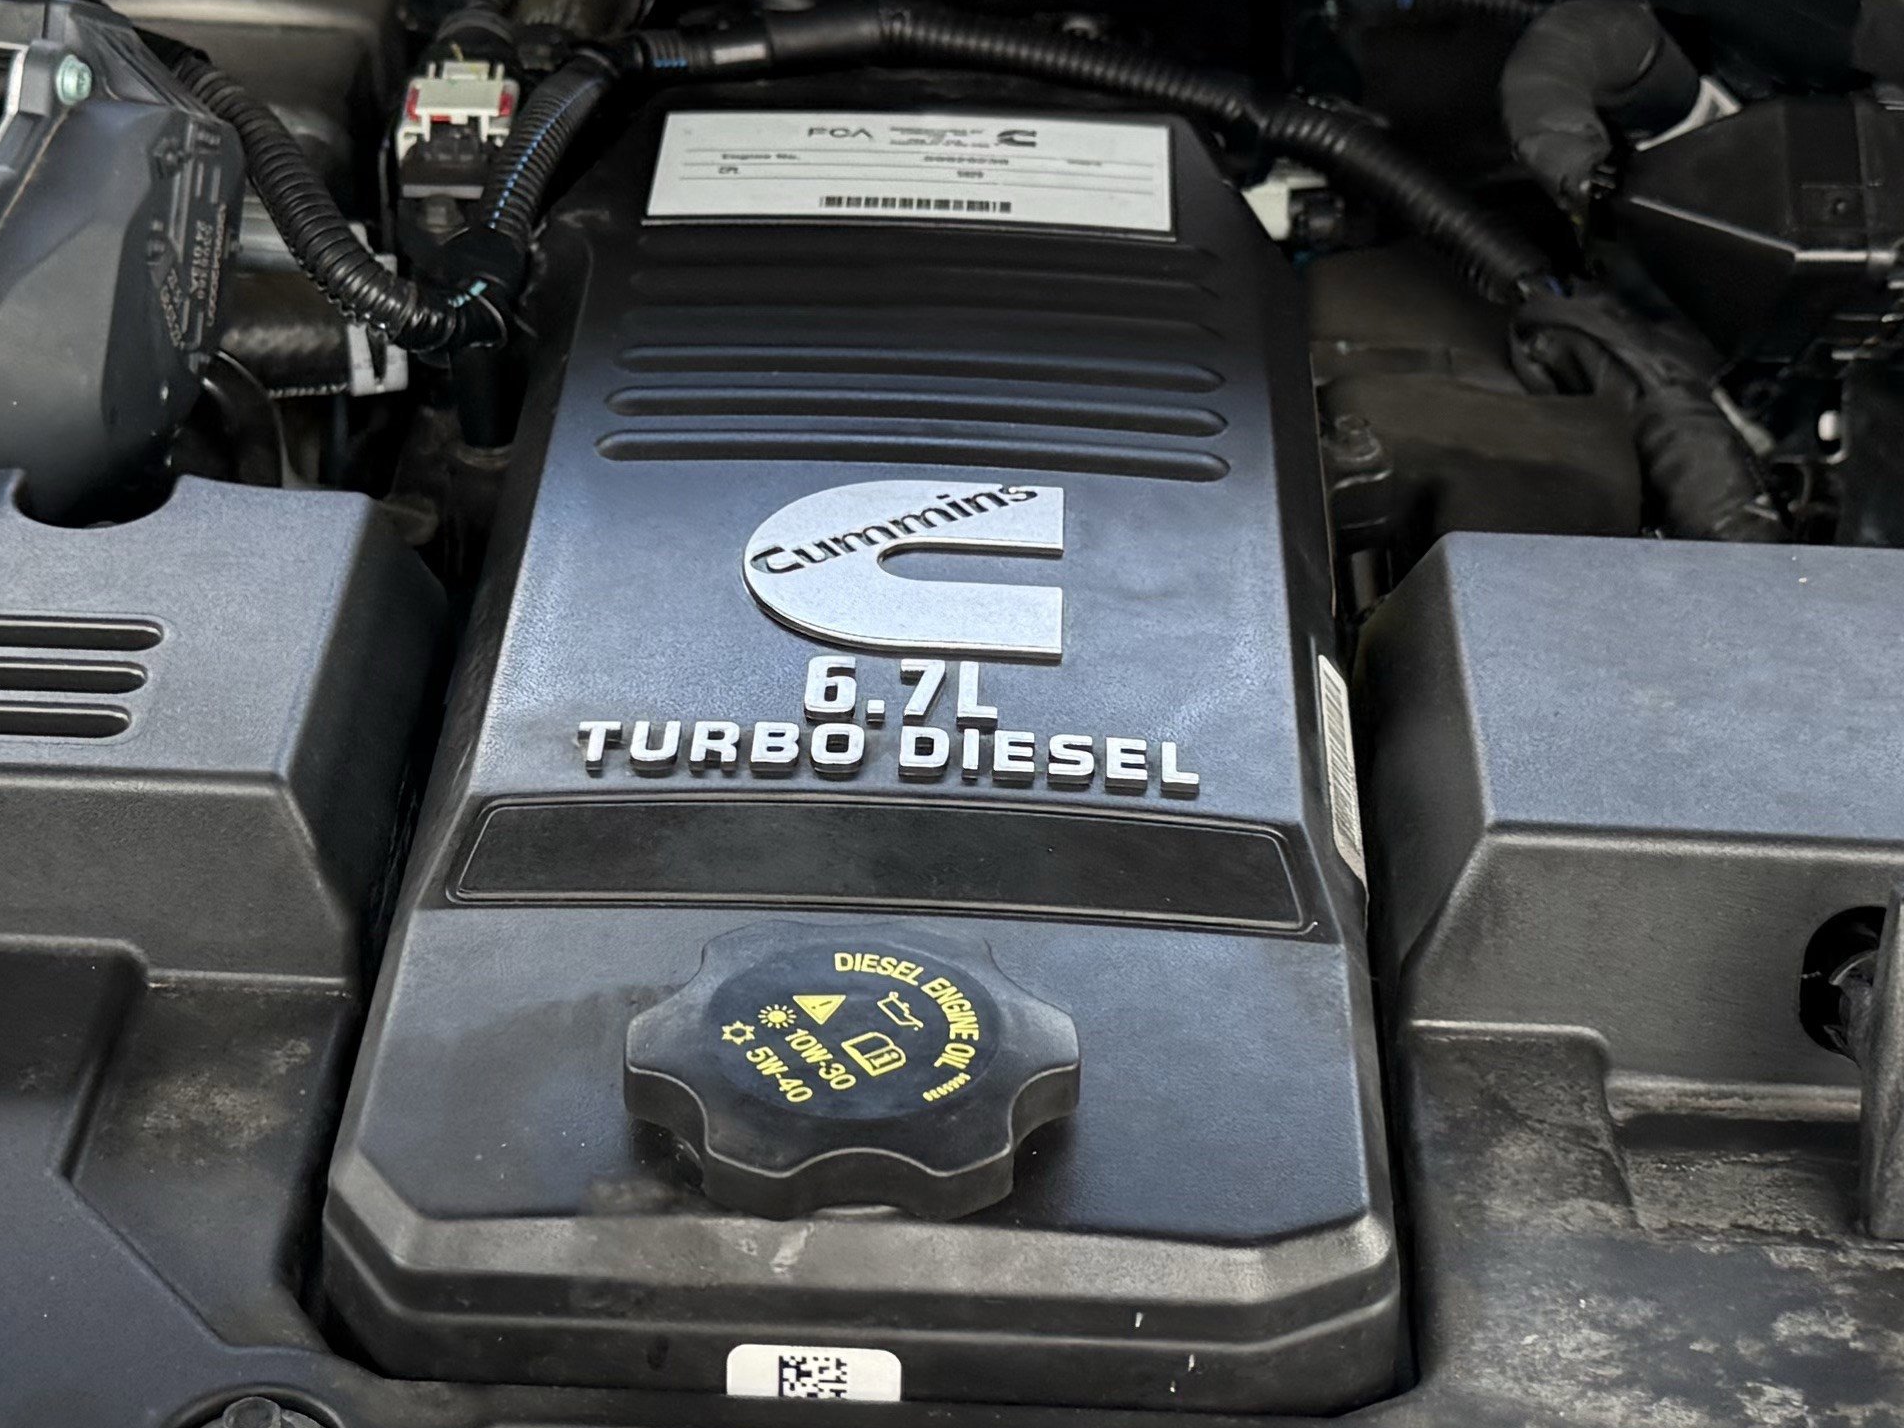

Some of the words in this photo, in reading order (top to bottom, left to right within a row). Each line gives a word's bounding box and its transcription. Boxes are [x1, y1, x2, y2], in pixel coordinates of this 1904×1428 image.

[750, 486, 1039, 574] Cummins
[804, 655, 998, 724] 6.7L
[578, 720, 866, 774] TURBO
[899, 725, 1201, 798] DIESEL
[834, 952, 924, 986] DIESEL
[920, 977, 979, 1041] ENGINE
[746, 1046, 813, 1103] 5W-40
[785, 1028, 857, 1090] 10W-30
[934, 1042, 976, 1070] OIL
